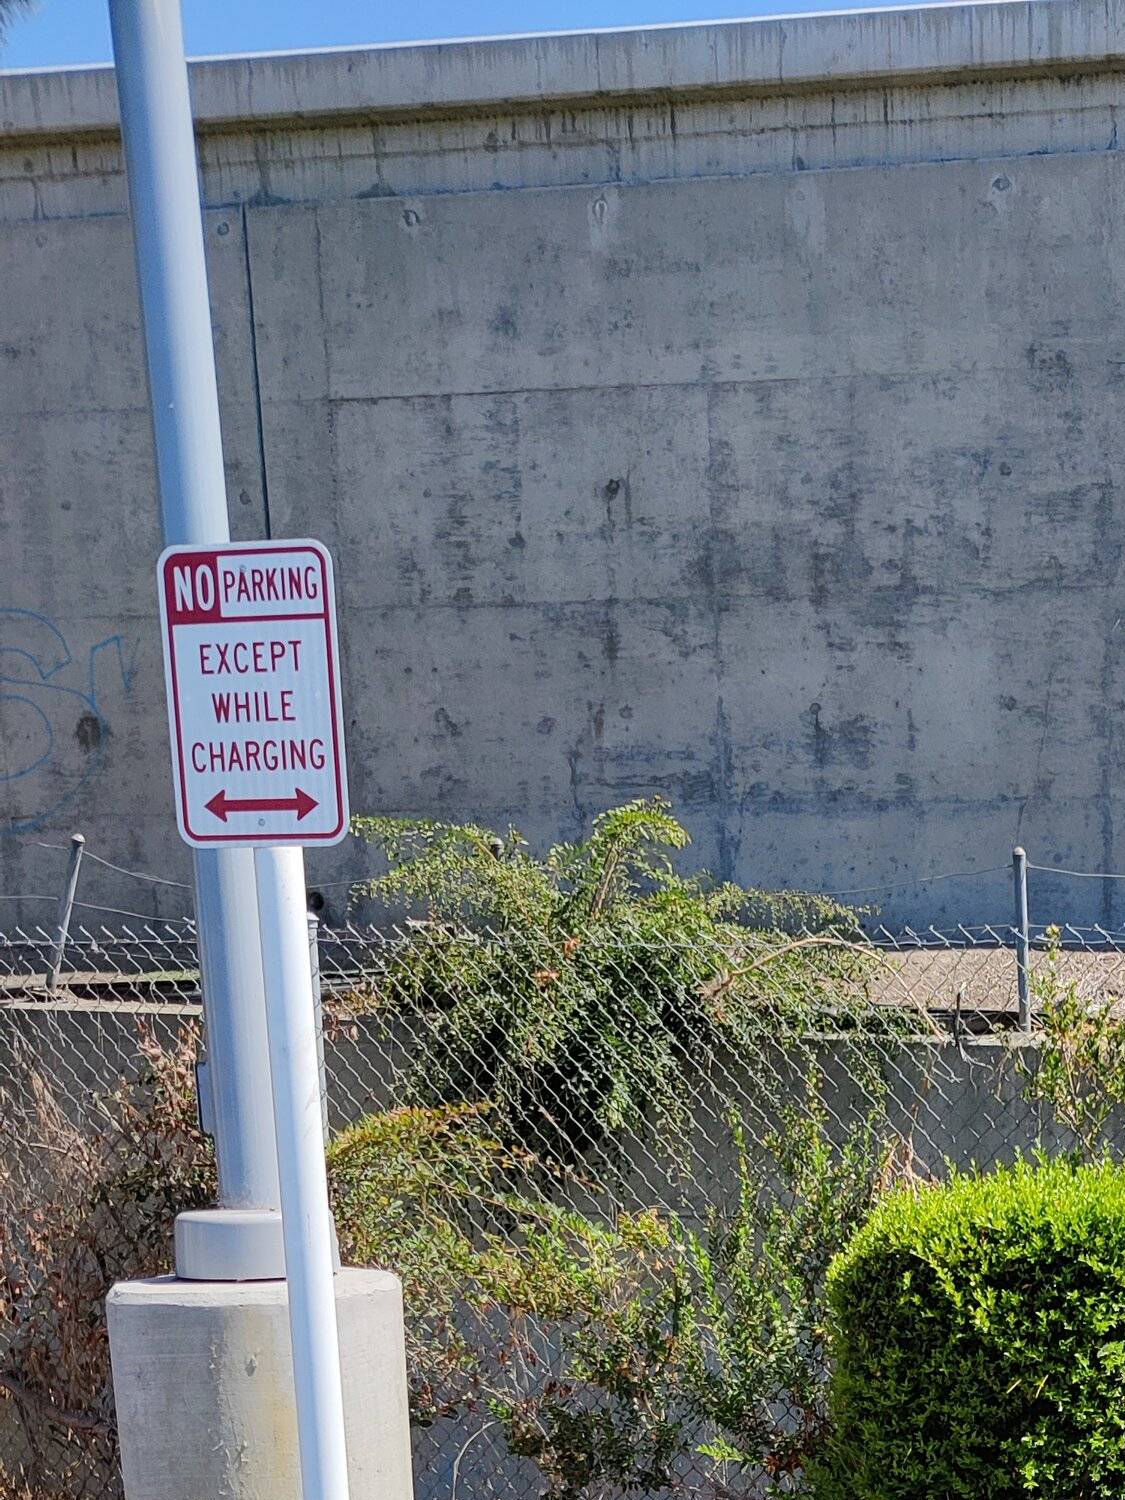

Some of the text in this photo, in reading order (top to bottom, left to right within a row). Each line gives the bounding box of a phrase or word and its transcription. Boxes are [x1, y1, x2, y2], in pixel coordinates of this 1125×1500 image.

[173, 563, 318, 612] NO PARKING
[199, 640, 302, 675] EXCEPT
[211, 690, 296, 724] WHILE
[191, 738, 326, 773] CHARGING
